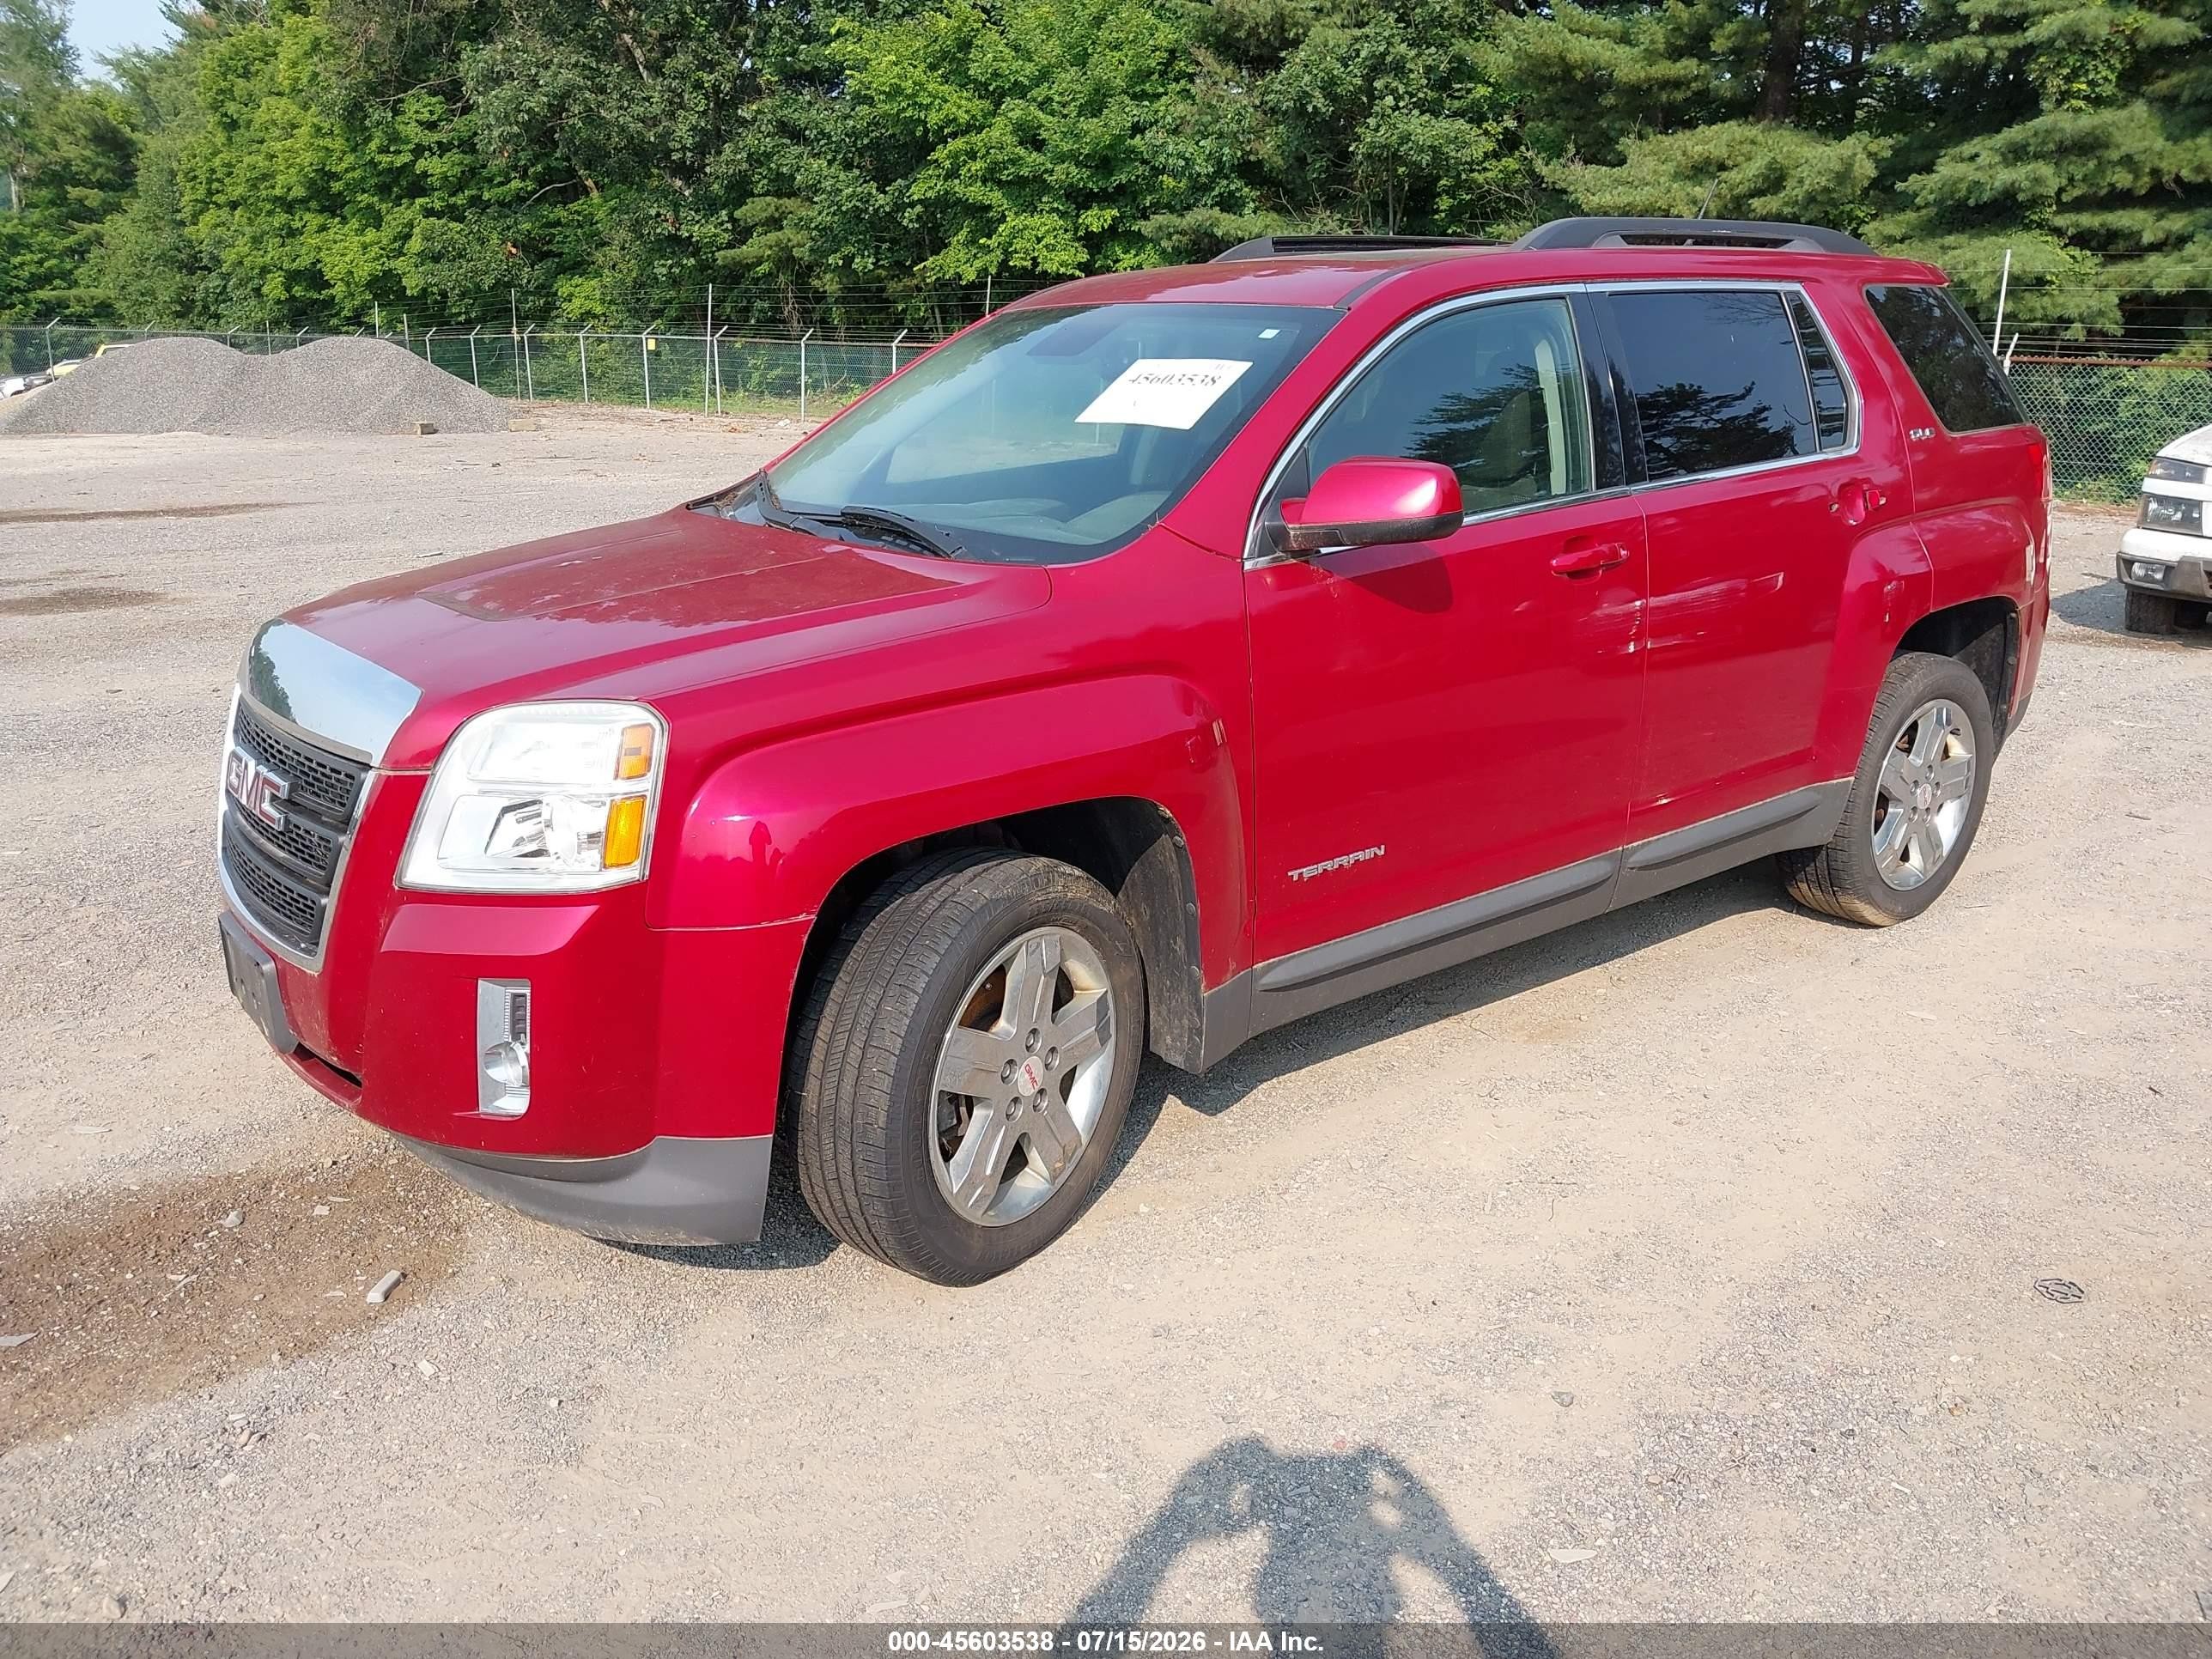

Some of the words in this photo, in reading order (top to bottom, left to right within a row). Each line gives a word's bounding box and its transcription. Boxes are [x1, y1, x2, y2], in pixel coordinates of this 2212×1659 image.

[1127, 373, 1222, 386] 45603538
[226, 745, 289, 832] GMC
[1287, 844, 1385, 881] TERRAIN
[1024, 1063, 1038, 1091] GMC
